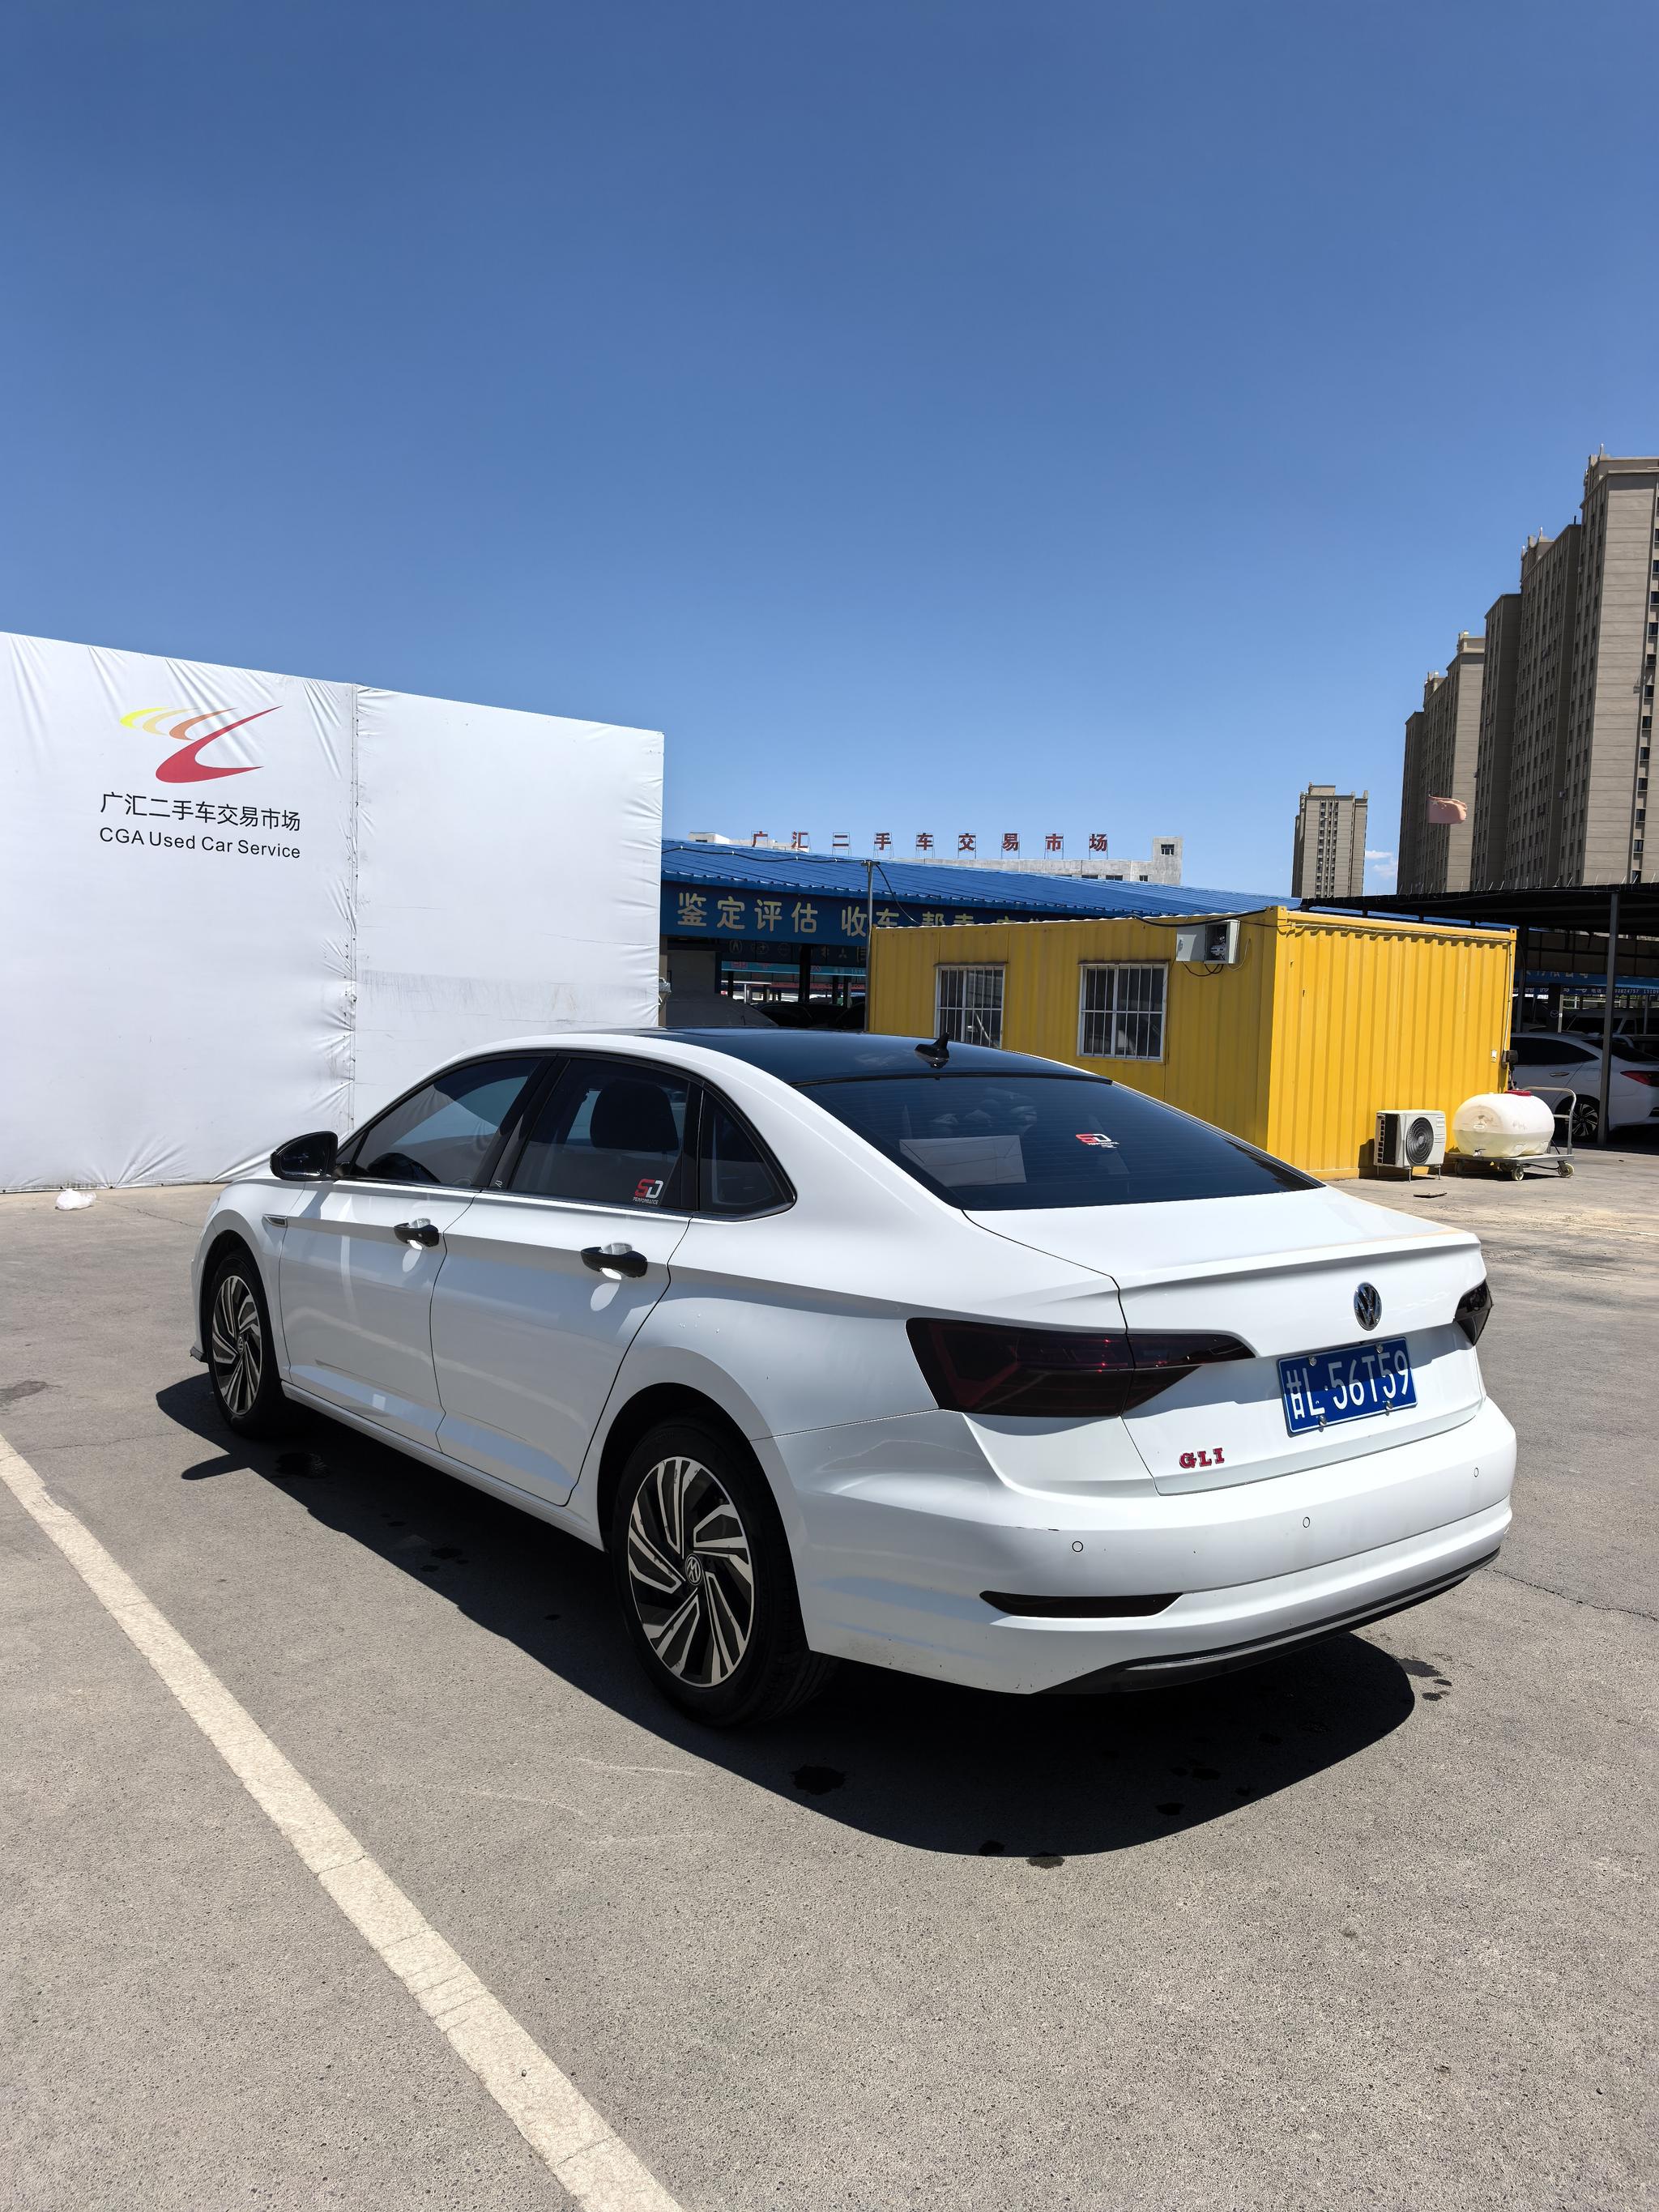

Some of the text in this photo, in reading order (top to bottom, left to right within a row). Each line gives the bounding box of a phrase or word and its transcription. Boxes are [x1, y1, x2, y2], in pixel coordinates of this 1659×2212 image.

[100, 791, 301, 832] 广汇二手车交易市场
[100, 827, 301, 859] CGA Used Car Service
[752, 831, 1108, 851] 广汇二手车交易市场
[677, 893, 818, 933] 鉴定评估
[1179, 1447, 1225, 1468] GLI
